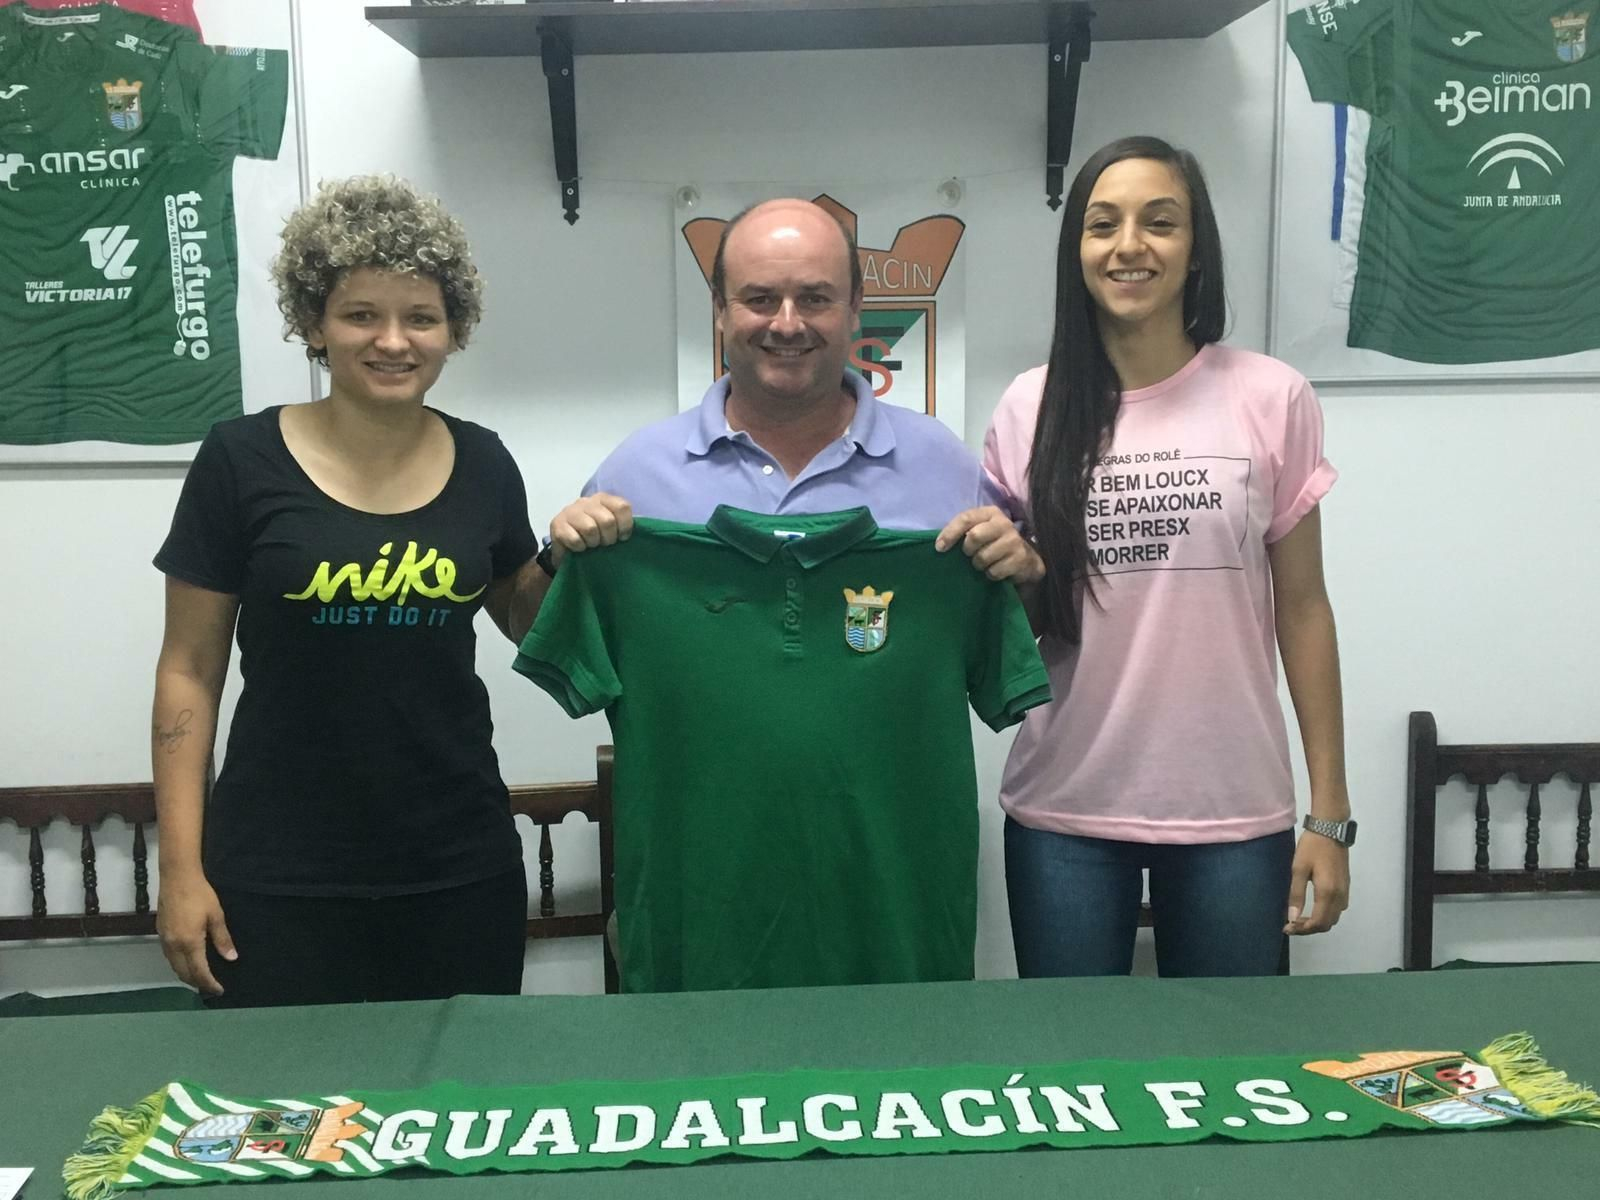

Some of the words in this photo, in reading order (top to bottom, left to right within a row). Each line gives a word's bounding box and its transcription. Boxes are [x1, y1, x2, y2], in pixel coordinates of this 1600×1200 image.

[1492, 71, 1541, 85] clinica
[1445, 80, 1591, 127] Beiman
[40, 148, 145, 173] ansar
[80, 177, 141, 189] CLINICA
[1463, 195, 1493, 207] JUNTA
[1497, 195, 1509, 207] DE
[166, 199, 184, 312] www.telefurgo.com
[176, 190, 211, 361] telefurgo
[863, 254, 932, 289] ACIN
[25, 280, 64, 290] TALLERES
[25, 288, 114, 303] VICTORIA
[117, 287, 133, 300] 17
[1096, 455, 1131, 466] EGRAS
[1135, 453, 1150, 464] DO
[1153, 449, 1181, 462] ROLÊ
[1101, 474, 1140, 493] BEM
[1145, 469, 1209, 490] LOUCX
[1087, 499, 1111, 518] SE
[1114, 492, 1222, 516] APAIXONAR
[1088, 522, 1125, 542] SER
[1129, 517, 1190, 539] PRESX
[312, 606, 377, 624] JUST
[389, 606, 420, 625] DO
[427, 609, 451, 626] IT
[370, 1072, 1121, 1162] GUADALCACÍN
[1144, 1078, 1350, 1129] F.S.
